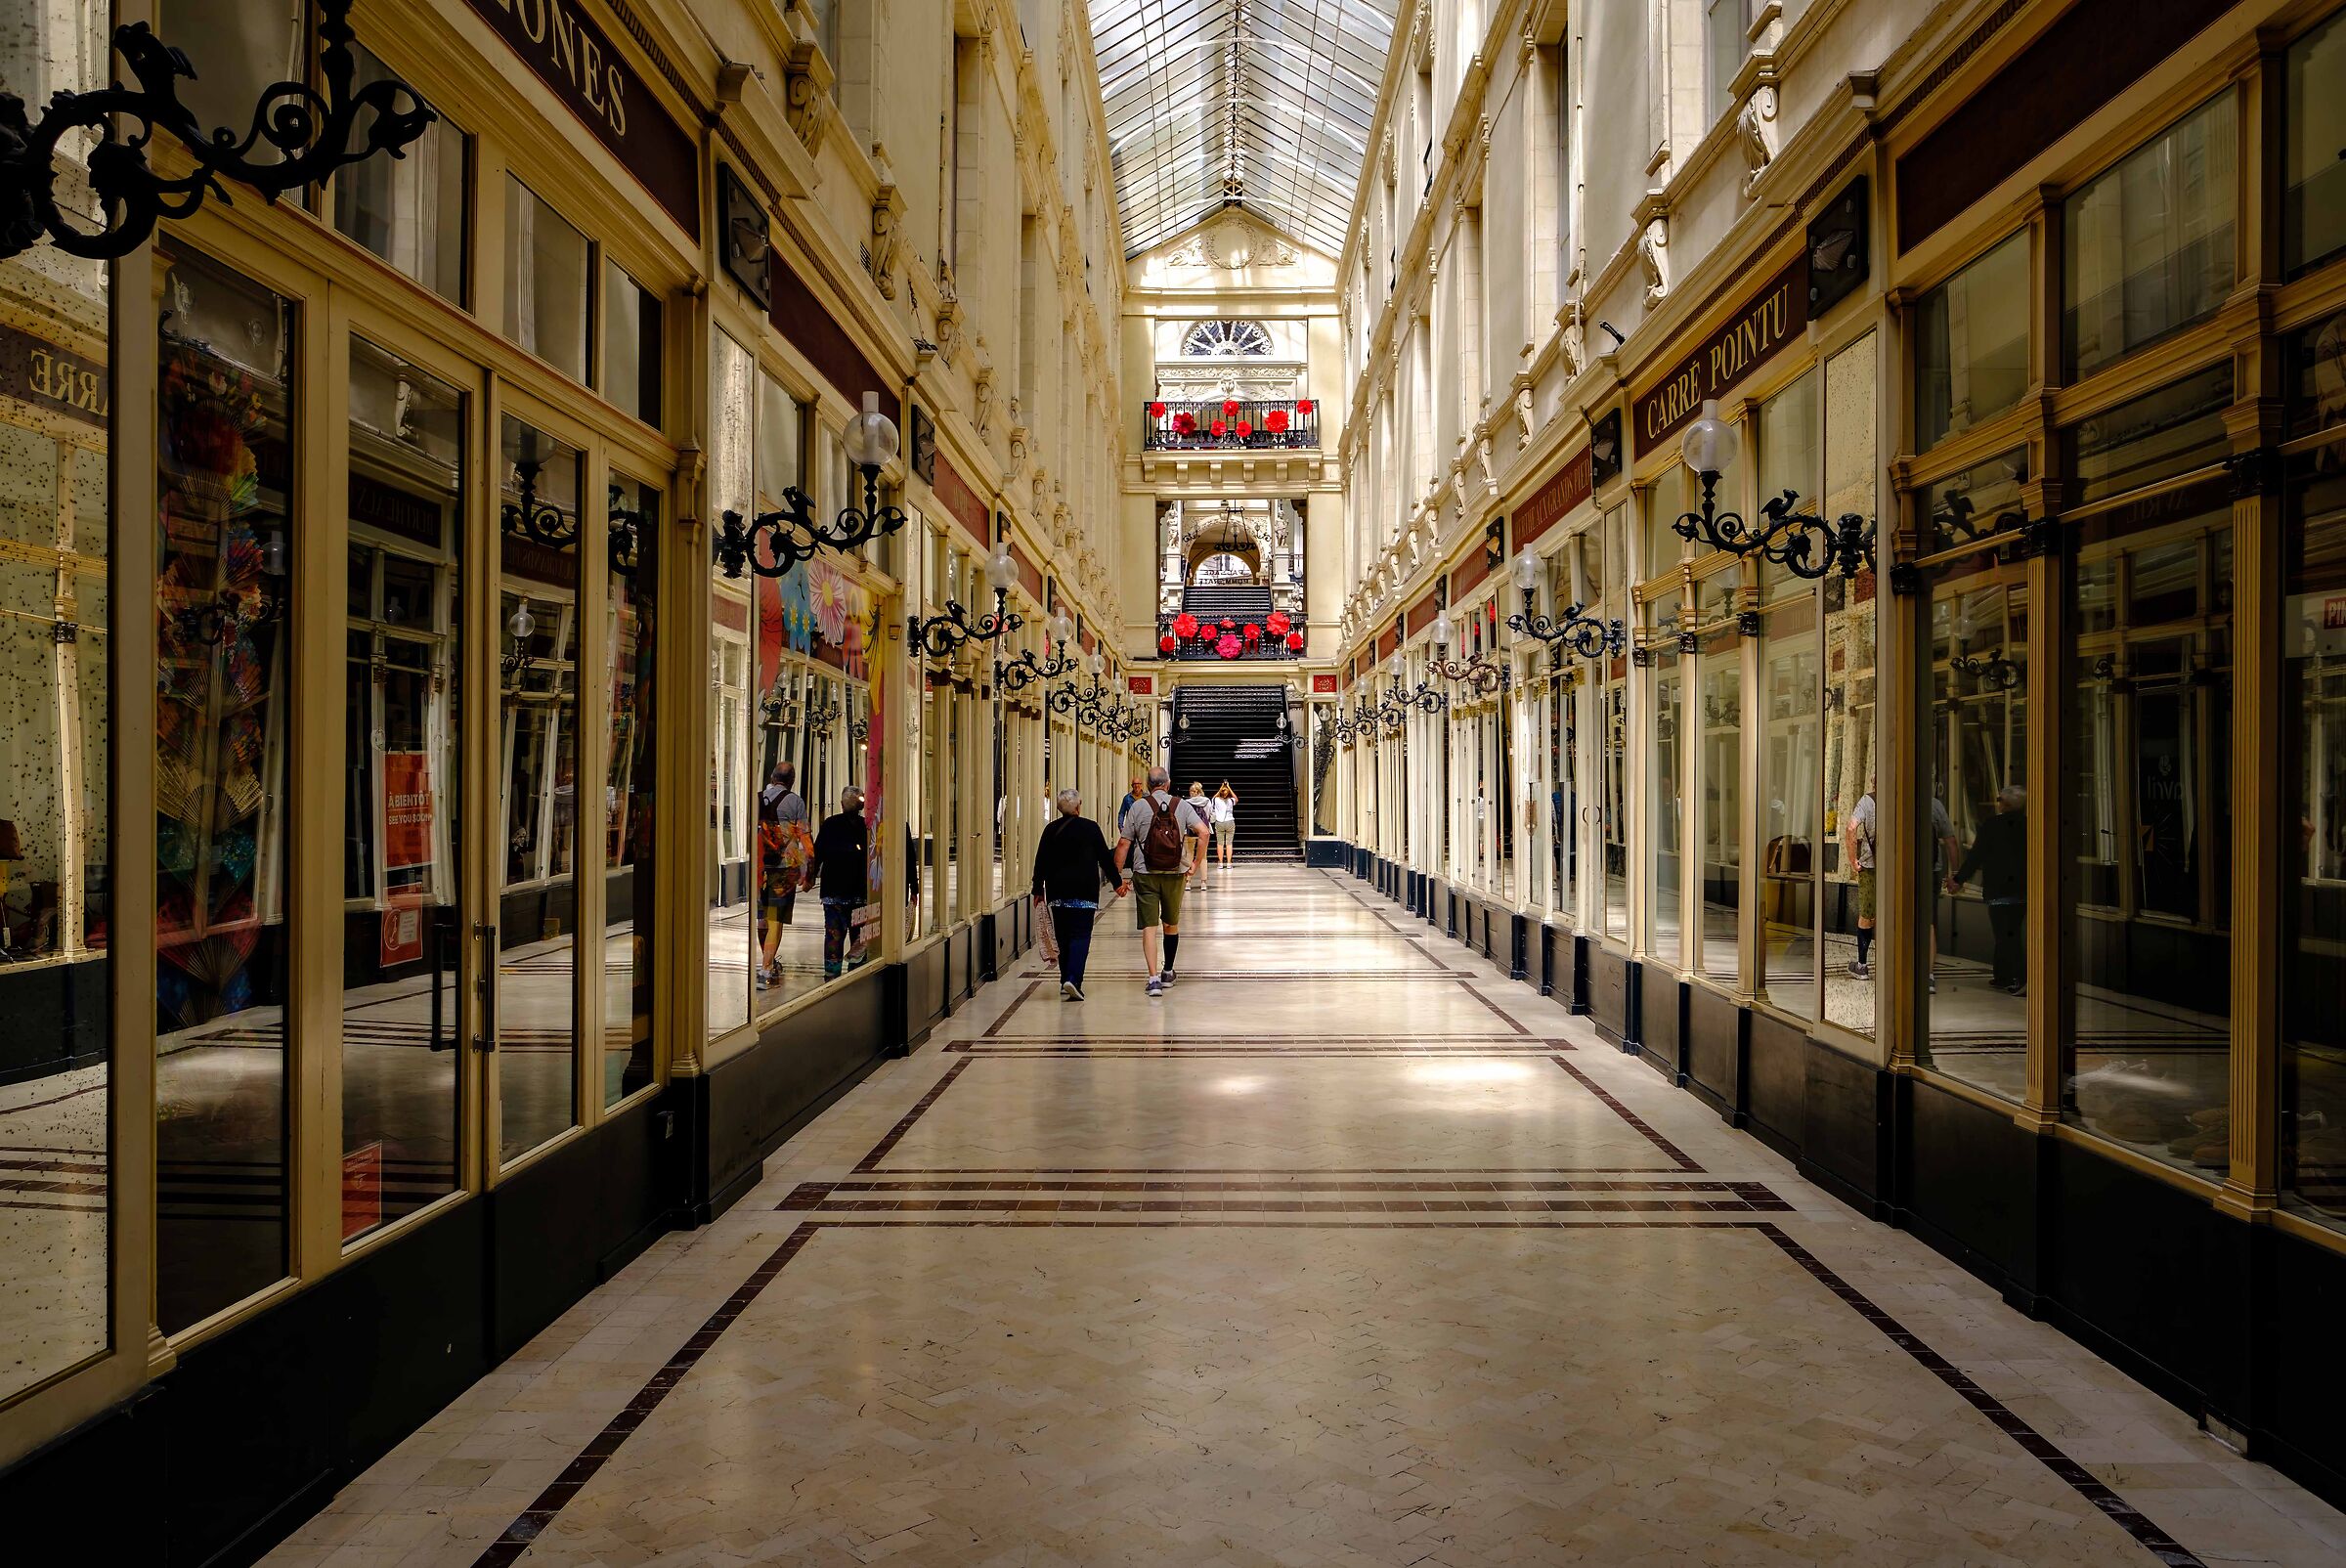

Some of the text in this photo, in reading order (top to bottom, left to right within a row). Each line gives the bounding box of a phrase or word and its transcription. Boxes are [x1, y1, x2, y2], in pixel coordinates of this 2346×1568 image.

[495, 0, 626, 138] ONES
[1647, 283, 1790, 440] CARRÉ POINTU
